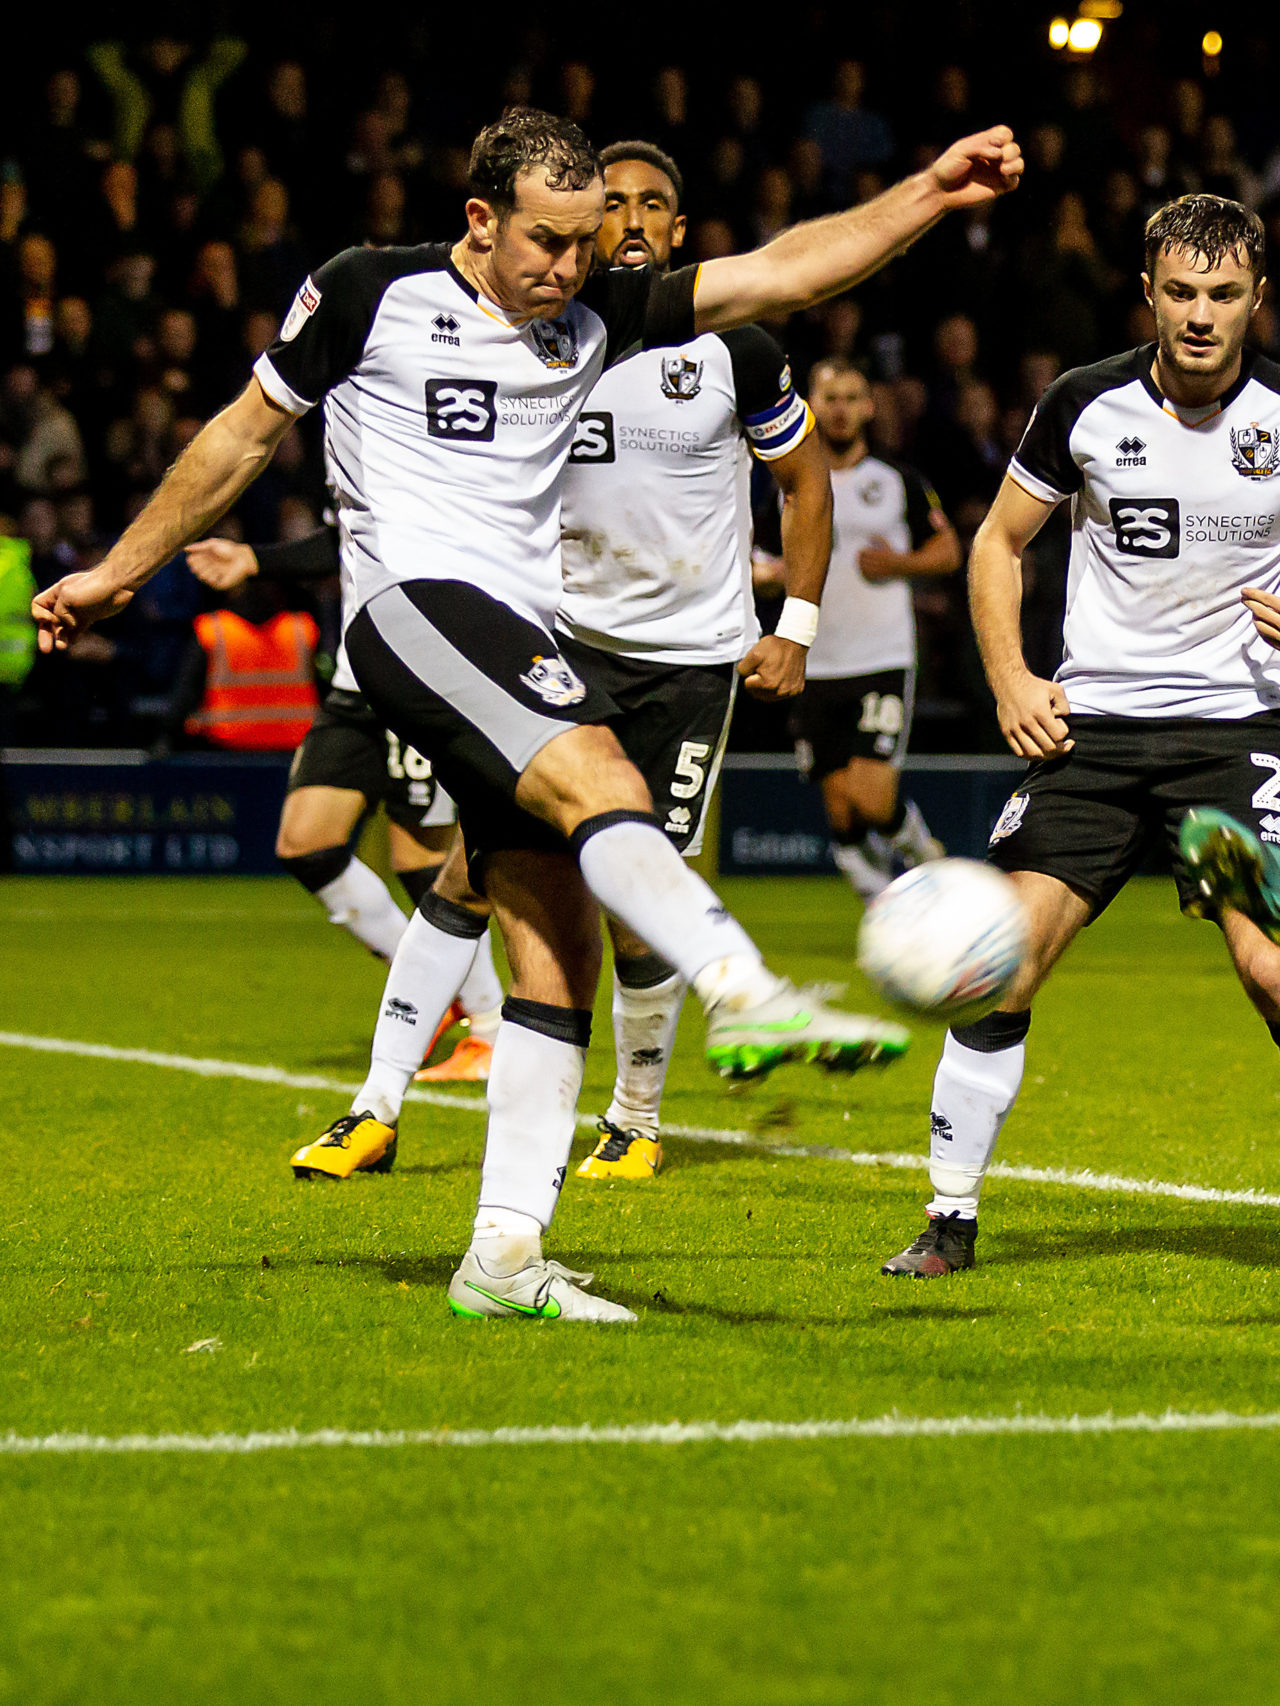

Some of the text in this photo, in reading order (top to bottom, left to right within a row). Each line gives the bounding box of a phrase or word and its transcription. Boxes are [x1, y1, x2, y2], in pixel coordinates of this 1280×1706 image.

[619, 426, 700, 441] SYNECTICS
[1116, 456, 1147, 467] errea
[1185, 514, 1275, 528] SYNECTICS
[1185, 527, 1271, 542] SOLUTIONS
[670, 741, 709, 799] 5
